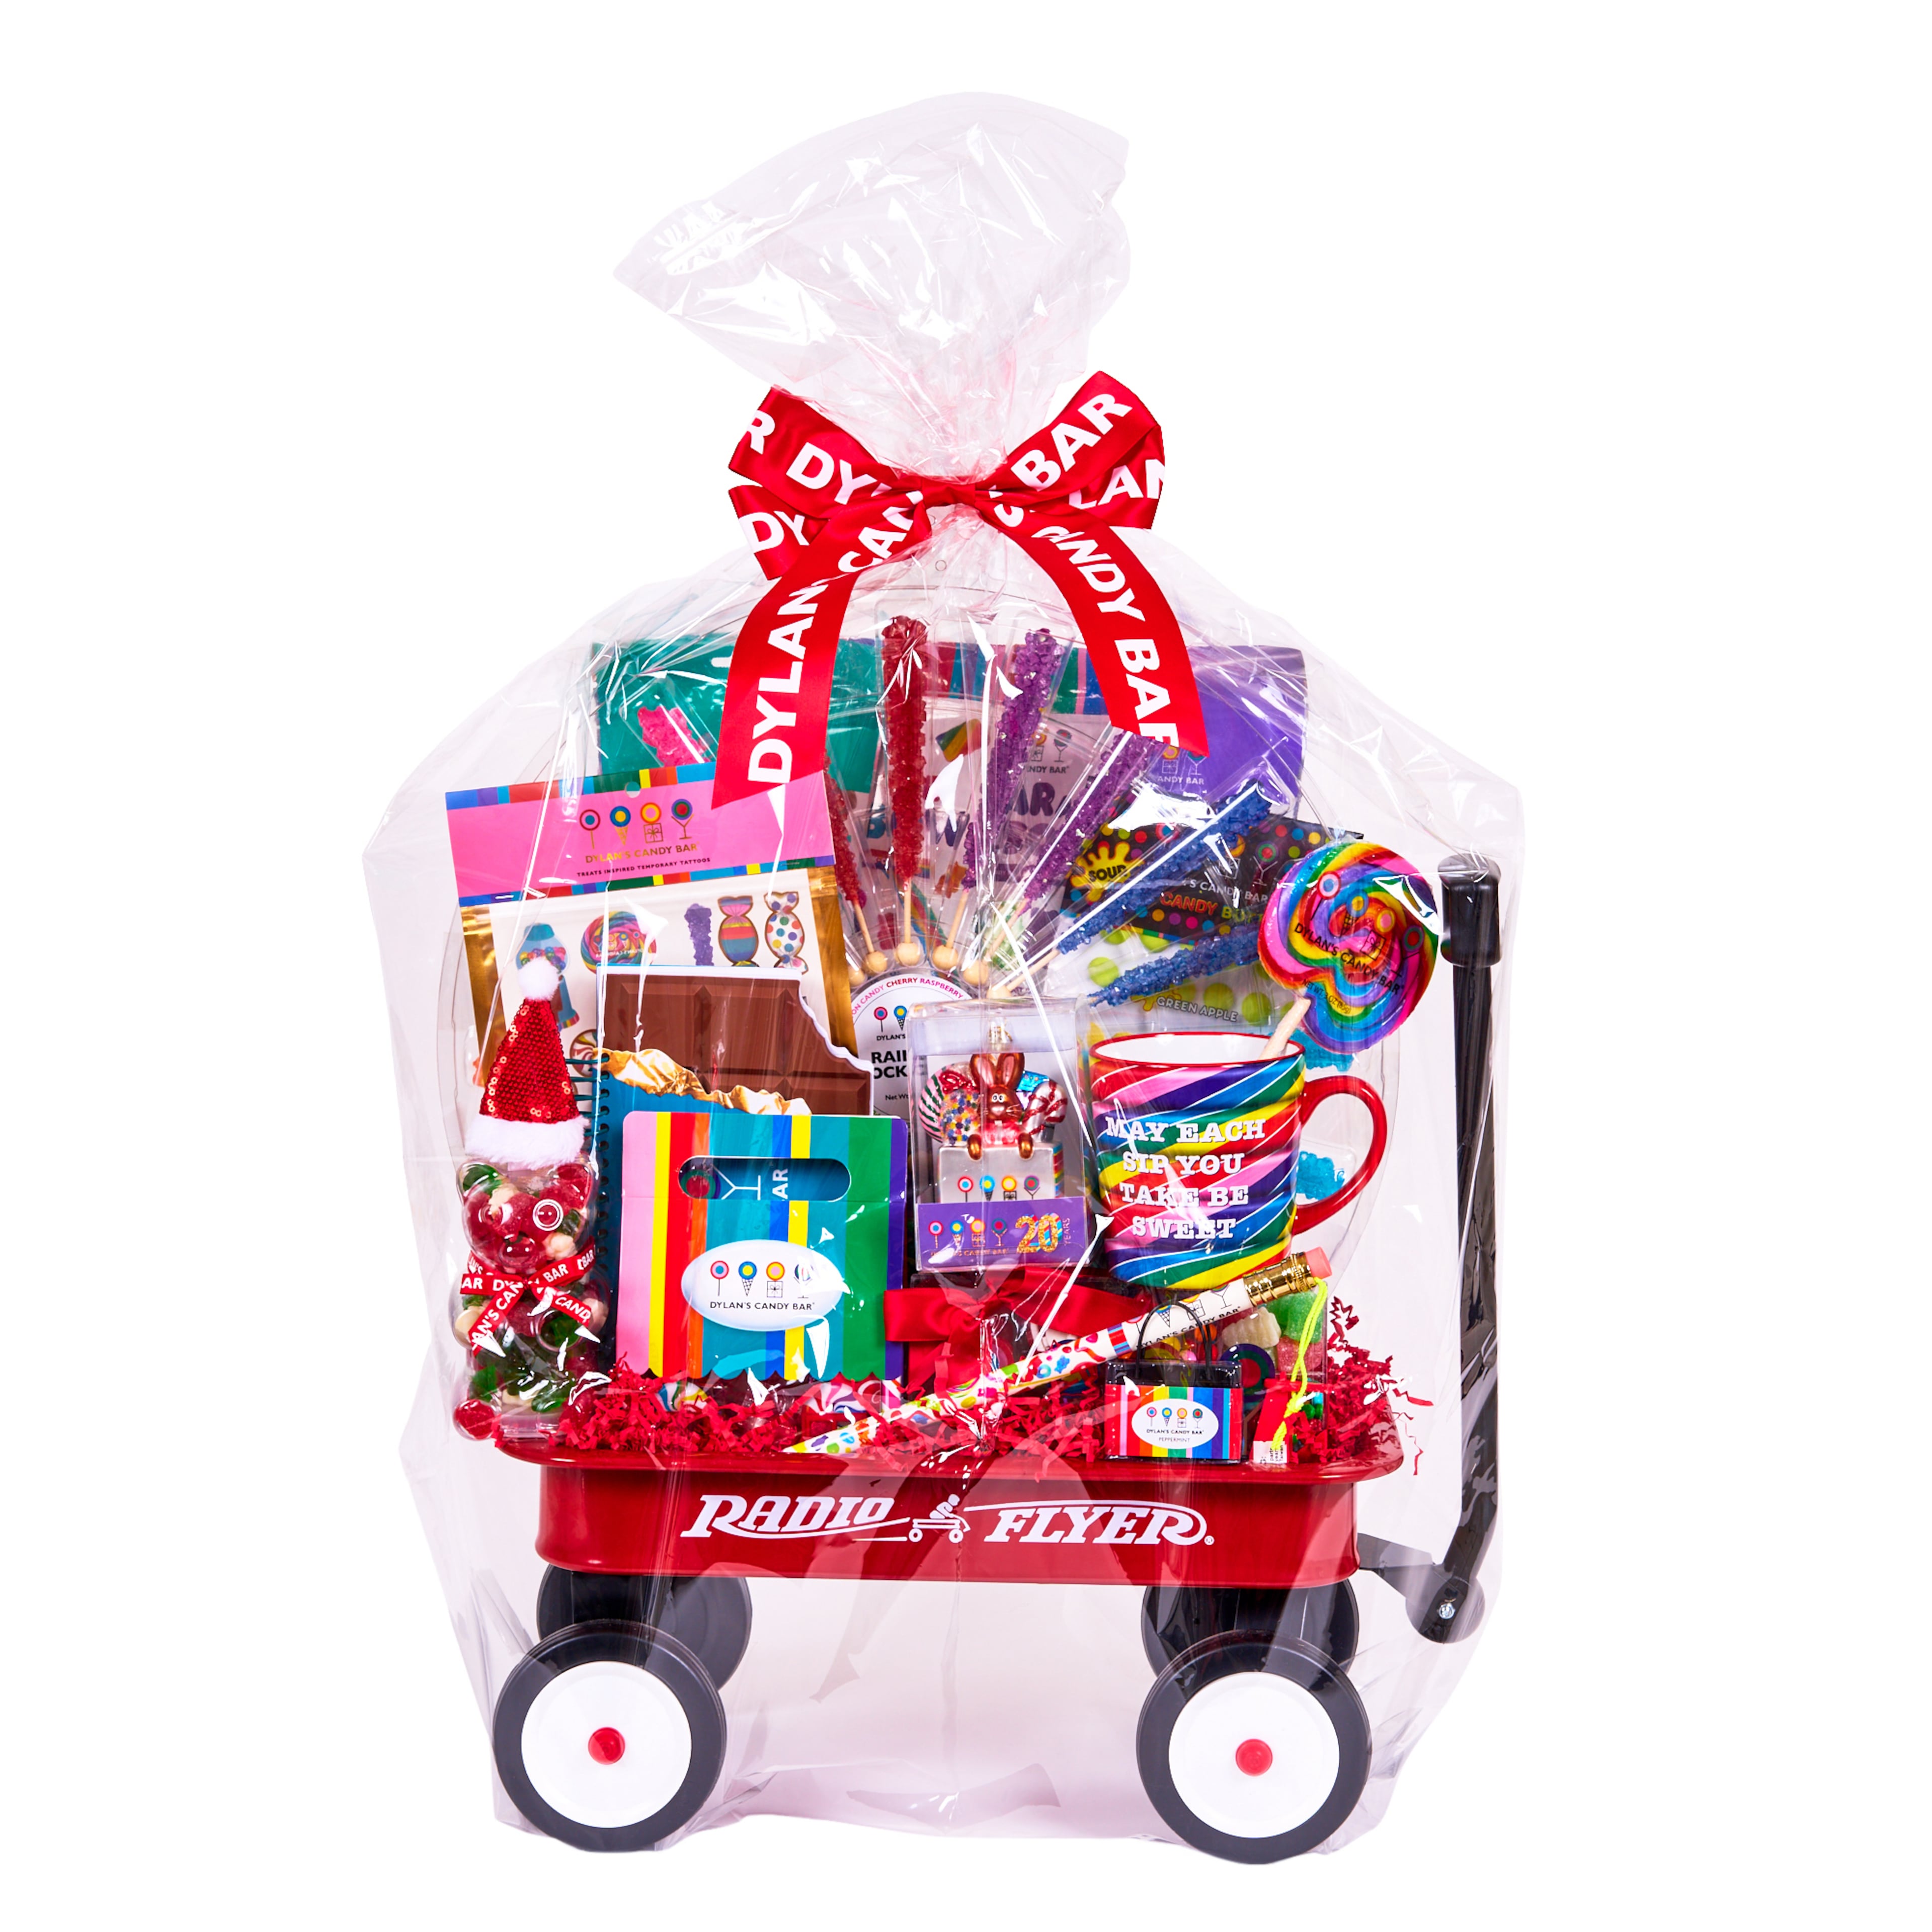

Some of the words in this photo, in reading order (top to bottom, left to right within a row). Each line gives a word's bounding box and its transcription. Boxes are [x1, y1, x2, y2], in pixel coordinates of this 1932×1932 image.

[1011, 394, 1133, 492] BAR
[748, 584, 828, 783] DYLAN
[1186, 776, 1204, 785] BAR
[586, 851, 631, 863] DYLAN'S
[634, 846, 672, 858] CANDY
[676, 843, 698, 853] BAR
[604, 866, 635, 874] INSPIRED
[637, 861, 678, 870] TEMPORARY
[1088, 865, 1126, 881] SOUR
[1160, 892, 1218, 916] CANDY
[1245, 891, 1268, 904] BAR
[1295, 922, 1339, 956] DYLAN'S
[1341, 952, 1379, 980] CANDY
[1379, 975, 1400, 995] BAR
[860, 985, 884, 1004] CANDY
[886, 978, 918, 988] CHERRY
[920, 978, 963, 999] RASPBERRY
[1157, 996, 1198, 1014] GREEN
[1199, 1005, 1239, 1022] APPLE
[874, 1065, 908, 1079] OCK
[1106, 1116, 1169, 1143] MAY
[1176, 1118, 1266, 1143] EACH
[1122, 1152, 1168, 1174] SIP
[1173, 1153, 1245, 1175] YOU
[772, 1168, 788, 1199] AR
[1119, 1183, 1199, 1207] TAKE
[1208, 1185, 1249, 1206] BE
[1015, 1213, 1063, 1253] 20
[1132, 1216, 1237, 1240] SWEET
[461, 1277, 483, 1290] AR
[542, 1264, 569, 1283] BAR
[496, 1282, 524, 1310] CAN
[710, 1301, 751, 1309] DYLAN'S
[555, 1297, 591, 1323] CAND
[1219, 1309, 1239, 1318] BAR
[680, 1494, 895, 1539] RADIO
[984, 1500, 1208, 1546] FLYER
